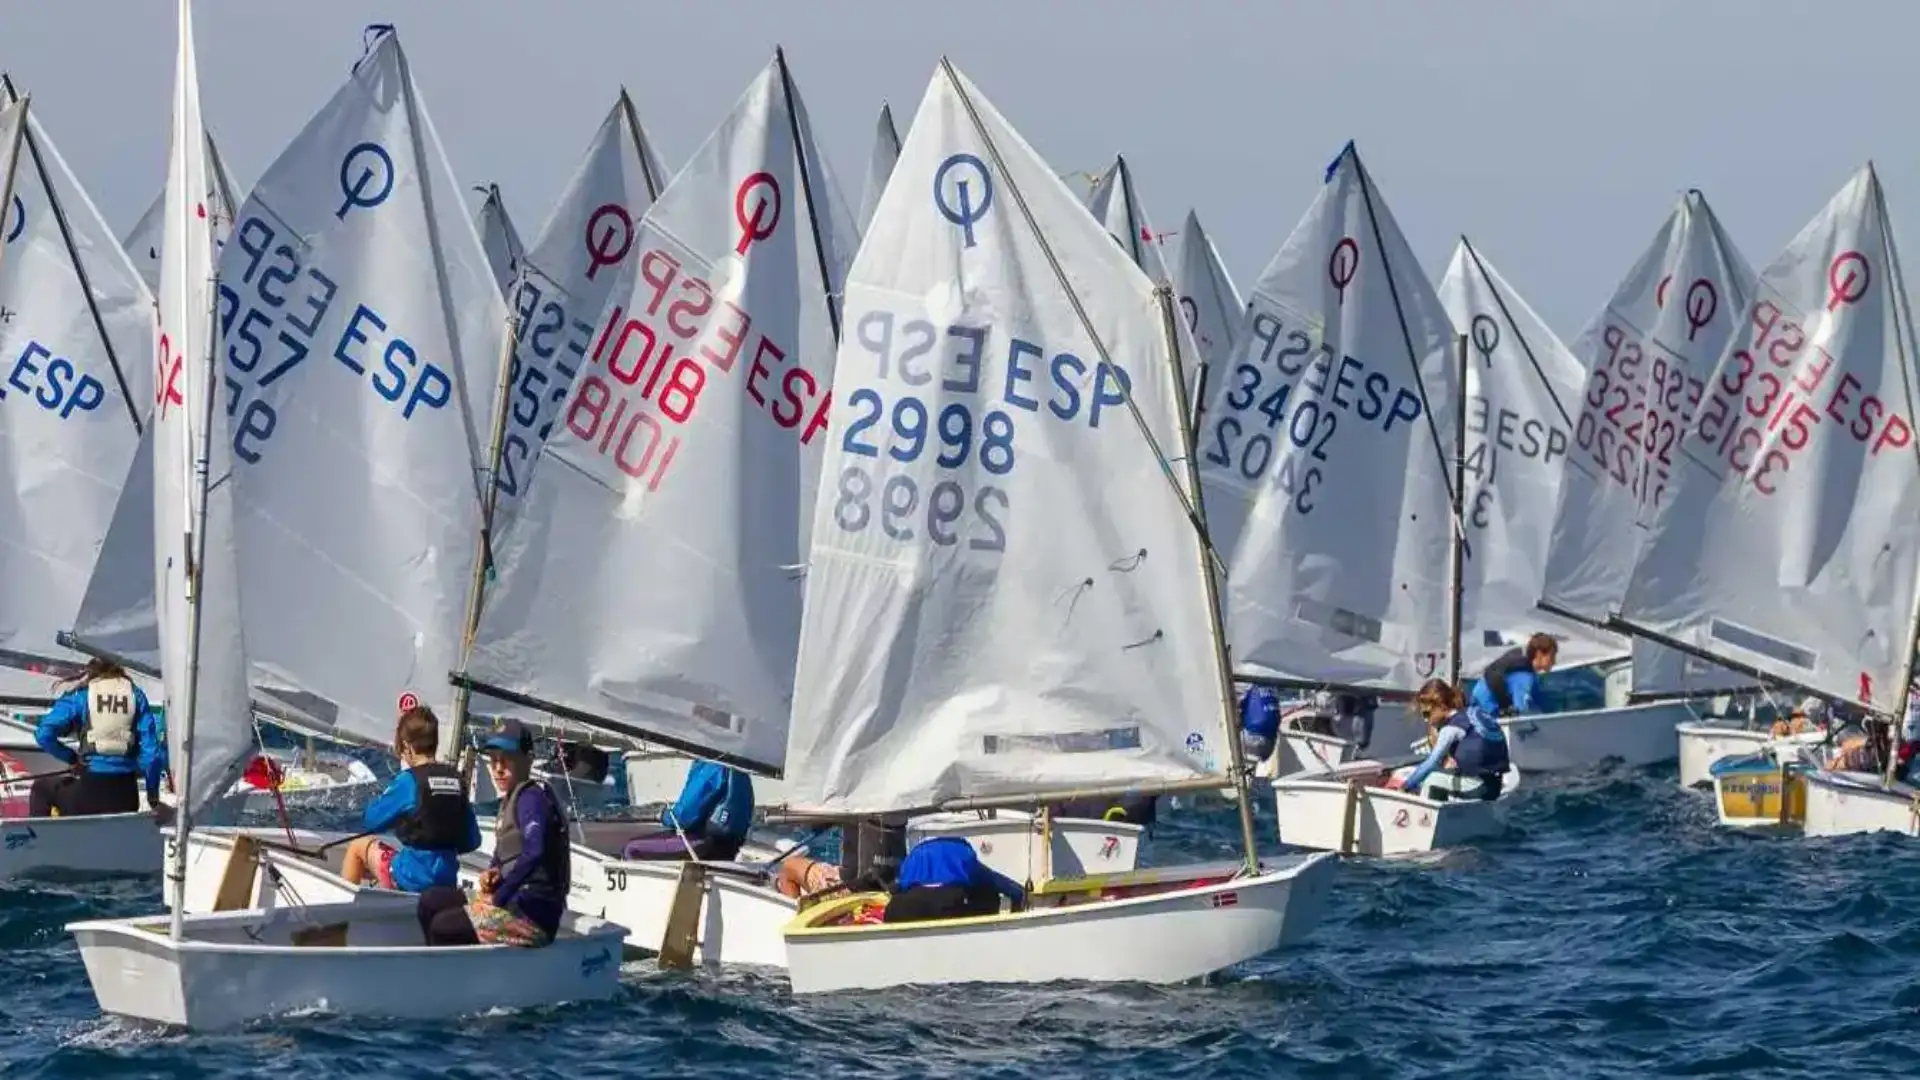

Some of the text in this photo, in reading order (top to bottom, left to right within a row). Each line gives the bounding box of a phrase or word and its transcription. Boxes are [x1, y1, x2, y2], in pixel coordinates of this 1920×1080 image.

[9, 341, 105, 420] ESP
[333, 302, 451, 420] ESP
[592, 306, 706, 424] 1018
[1004, 338, 1132, 428] ESP
[1332, 355, 1423, 433] ESP
[1721, 350, 1822, 451] 3315
[842, 388, 1015, 475] 2998
[1227, 364, 1337, 462] 3402
[1497, 408, 1568, 464] ESP
[1826, 372, 1912, 455] ESP
[96, 694, 129, 715] HH
[607, 869, 627, 891] 50
